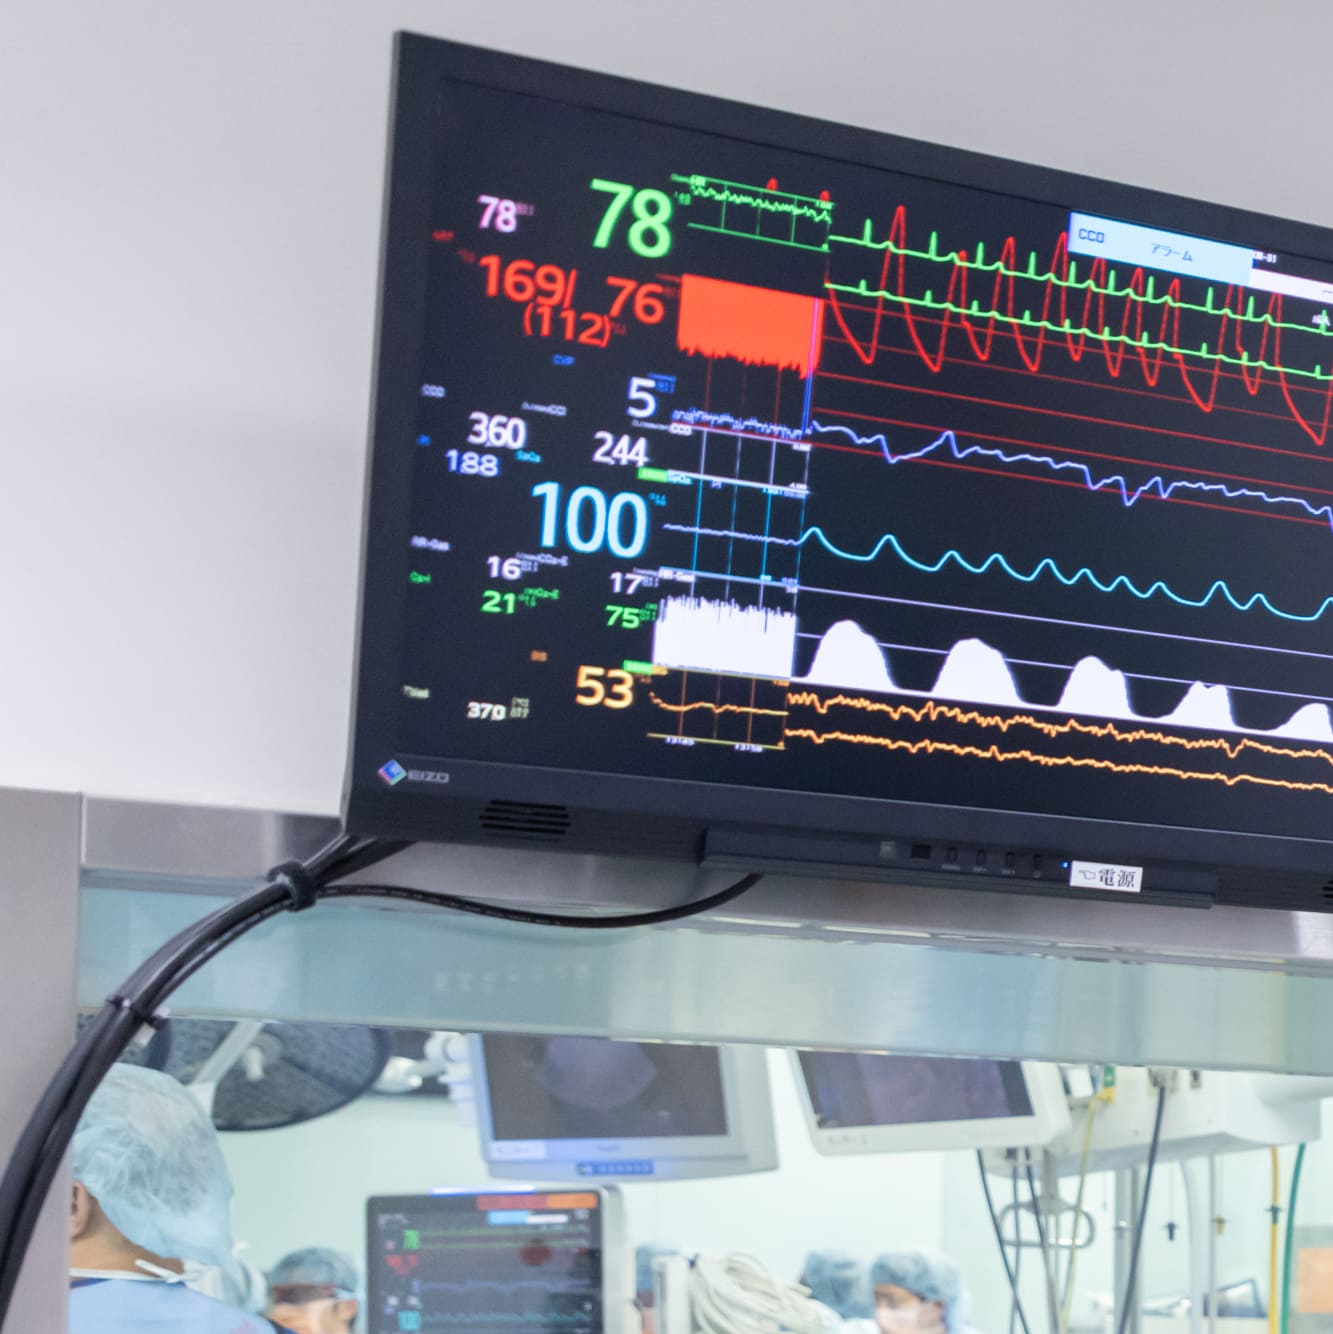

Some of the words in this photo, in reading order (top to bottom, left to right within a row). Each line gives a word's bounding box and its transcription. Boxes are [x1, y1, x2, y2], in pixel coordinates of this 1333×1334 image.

[476, 195, 518, 232] 78
[589, 179, 673, 258] 78
[1079, 228, 1104, 243] CCO
[1151, 243, 1192, 262] アラーム
[605, 276, 665, 324] 76
[523, 302, 612, 348] (112)
[627, 376, 657, 418] 5
[531, 481, 648, 558] 100
[486, 555, 523, 580] 16
[609, 572, 642, 595] 17
[480, 590, 516, 614] 21
[605, 604, 641, 629] 75
[575, 665, 634, 709] 53
[408, 769, 450, 784] EIZO
[1098, 868, 1136, 888] 電源
